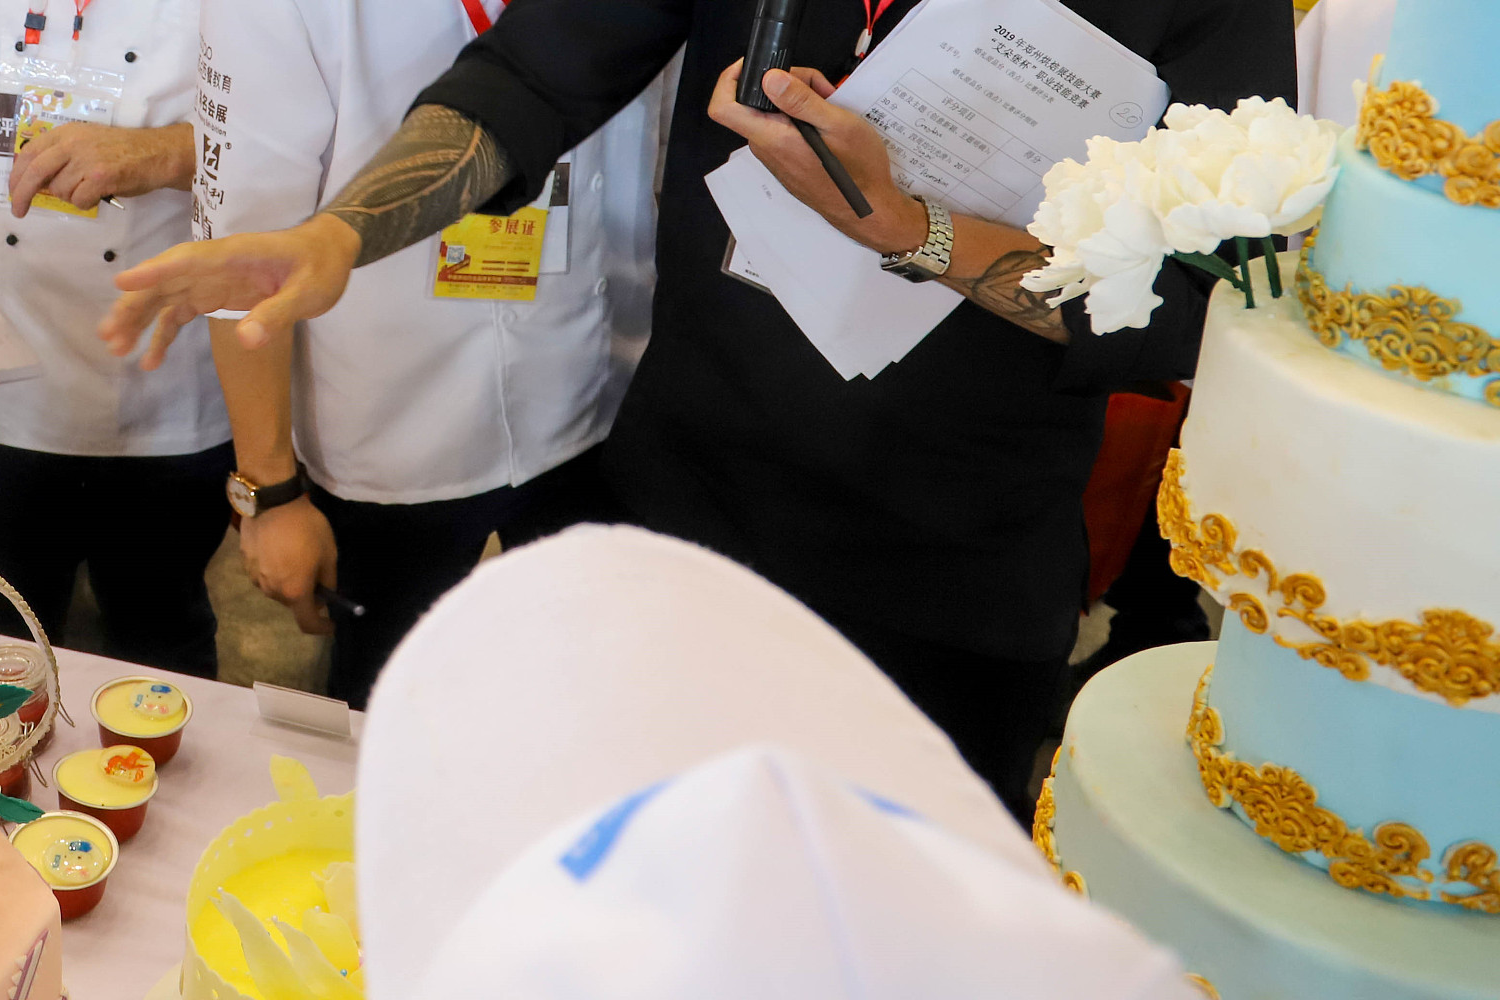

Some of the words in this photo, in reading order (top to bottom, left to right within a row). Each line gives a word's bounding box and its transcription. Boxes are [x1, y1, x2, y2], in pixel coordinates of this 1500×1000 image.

[994, 24, 1016, 42] 2019
[941, 96, 976, 121] 评分项目
[489, 217, 536, 236] 参展证
